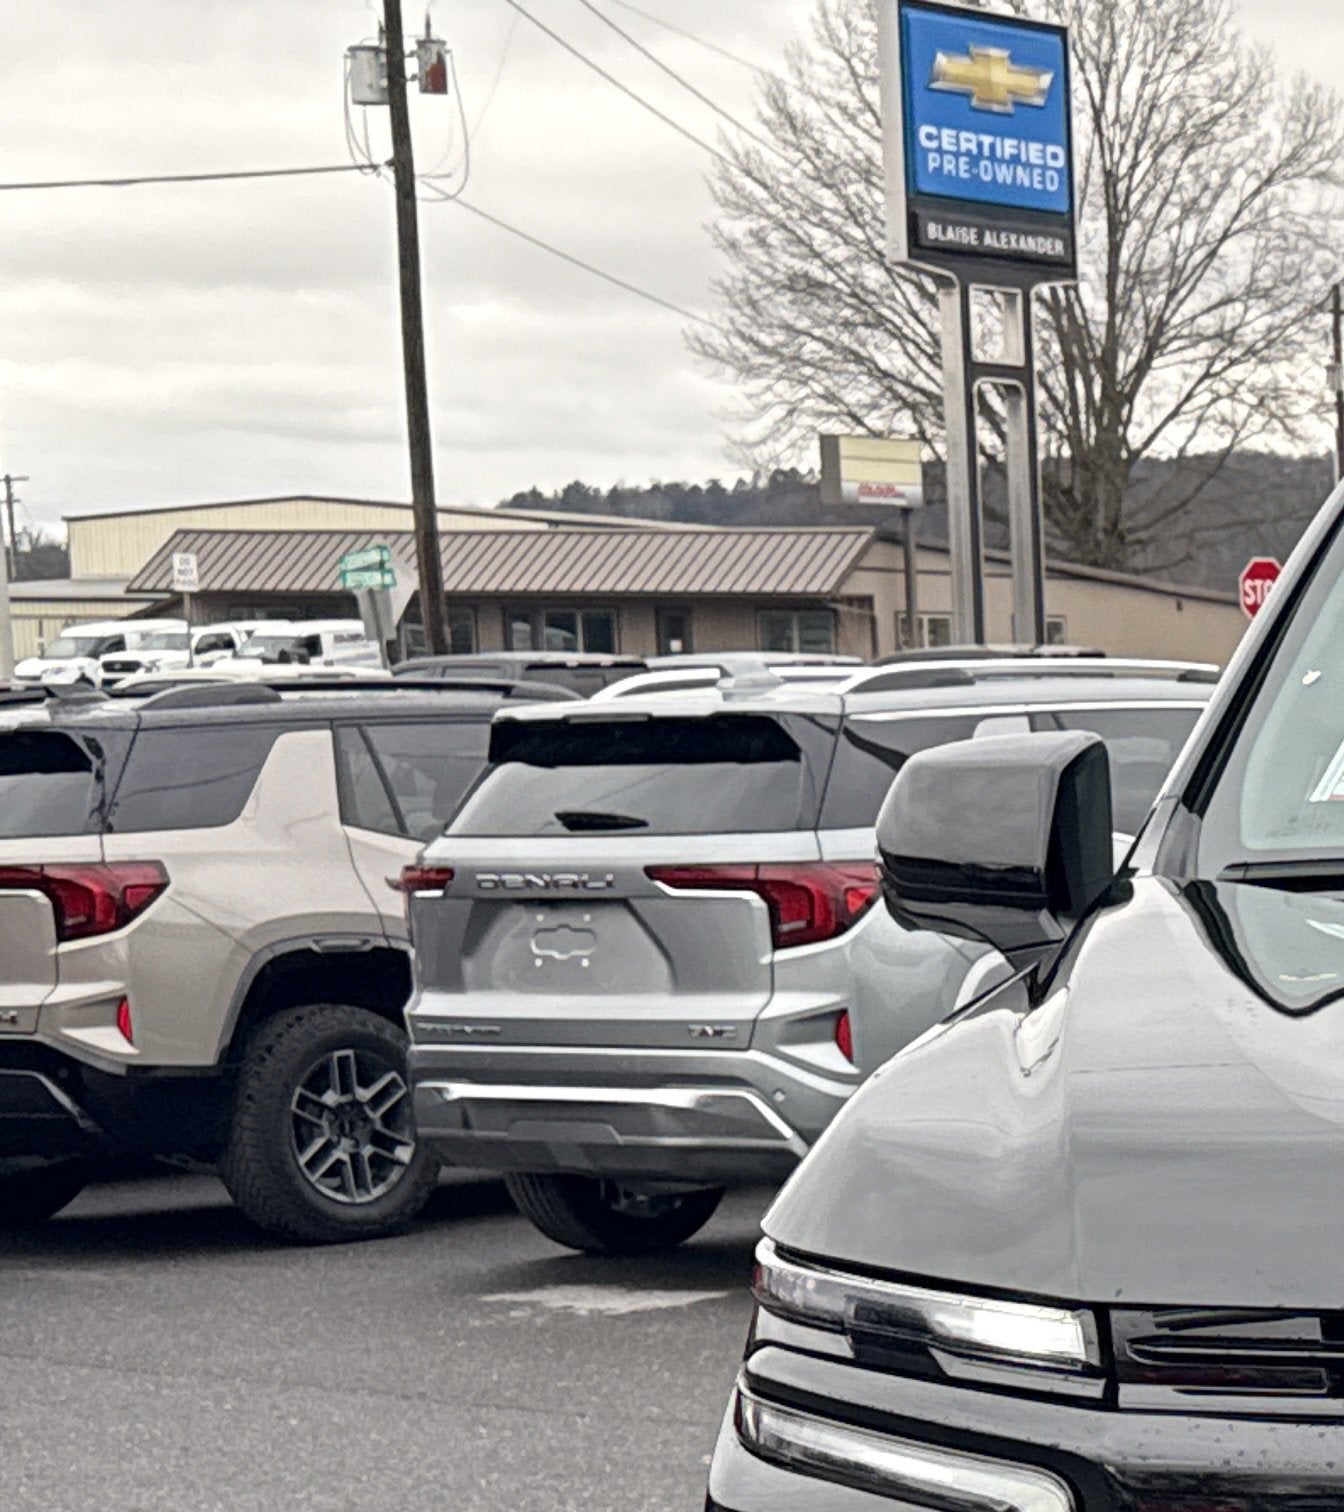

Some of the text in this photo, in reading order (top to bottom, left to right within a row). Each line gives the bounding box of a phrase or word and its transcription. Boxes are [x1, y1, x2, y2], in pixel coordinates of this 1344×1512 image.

[918, 125, 1065, 168] CERTIFIED
[928, 151, 1060, 192] PRE-OWNED
[927, 222, 1065, 255] BLAISE ALEXANDER
[1244, 579, 1274, 605] STO
[475, 873, 614, 889] DENALI
